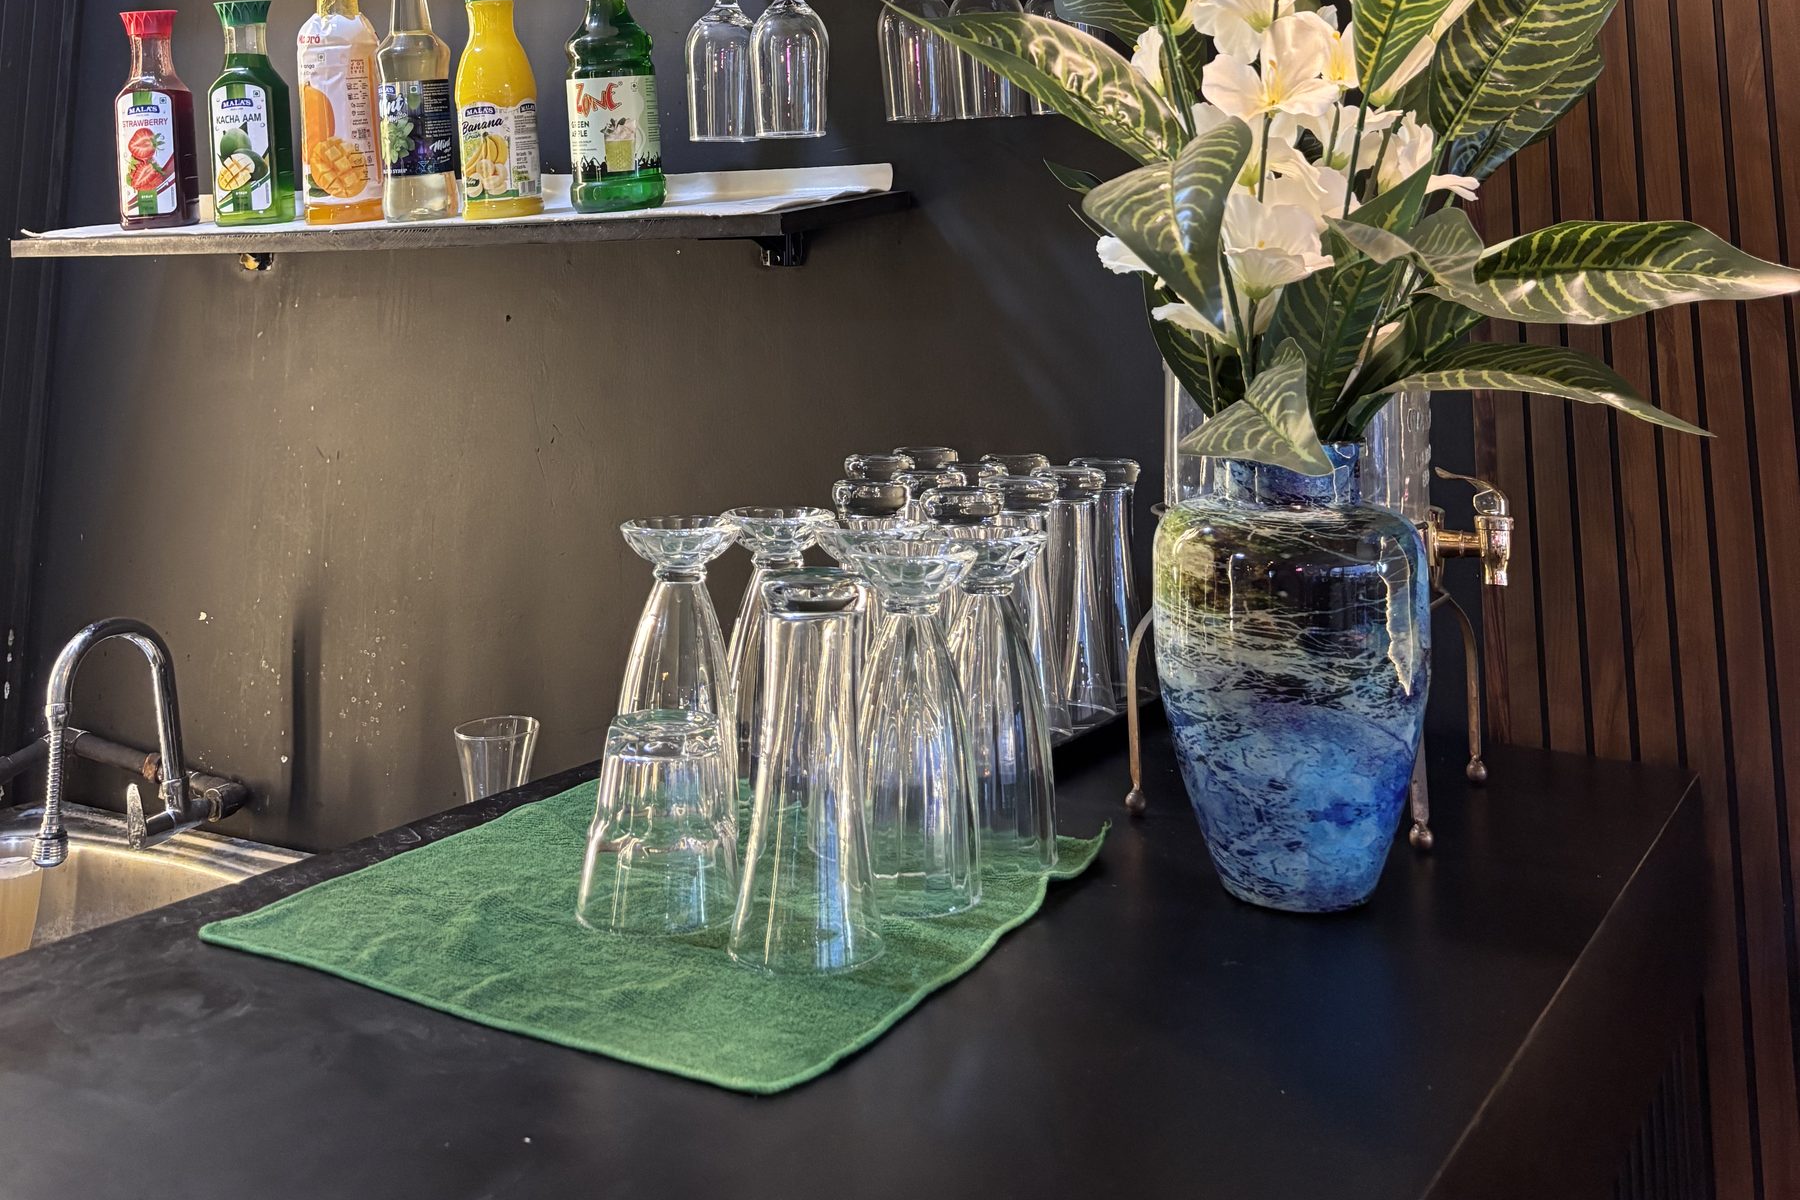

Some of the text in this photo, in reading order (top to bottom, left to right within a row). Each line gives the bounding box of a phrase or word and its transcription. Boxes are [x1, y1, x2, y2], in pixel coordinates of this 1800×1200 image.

[222, 99, 252, 108] MALA'S
[128, 106, 158, 114] MALA'S
[466, 107, 494, 116] MALA'S
[216, 113, 262, 124] KACHA AAM
[122, 118, 169, 129] STRAWBERRY
[461, 117, 504, 135] Banana
[571, 120, 590, 128] GEEN
